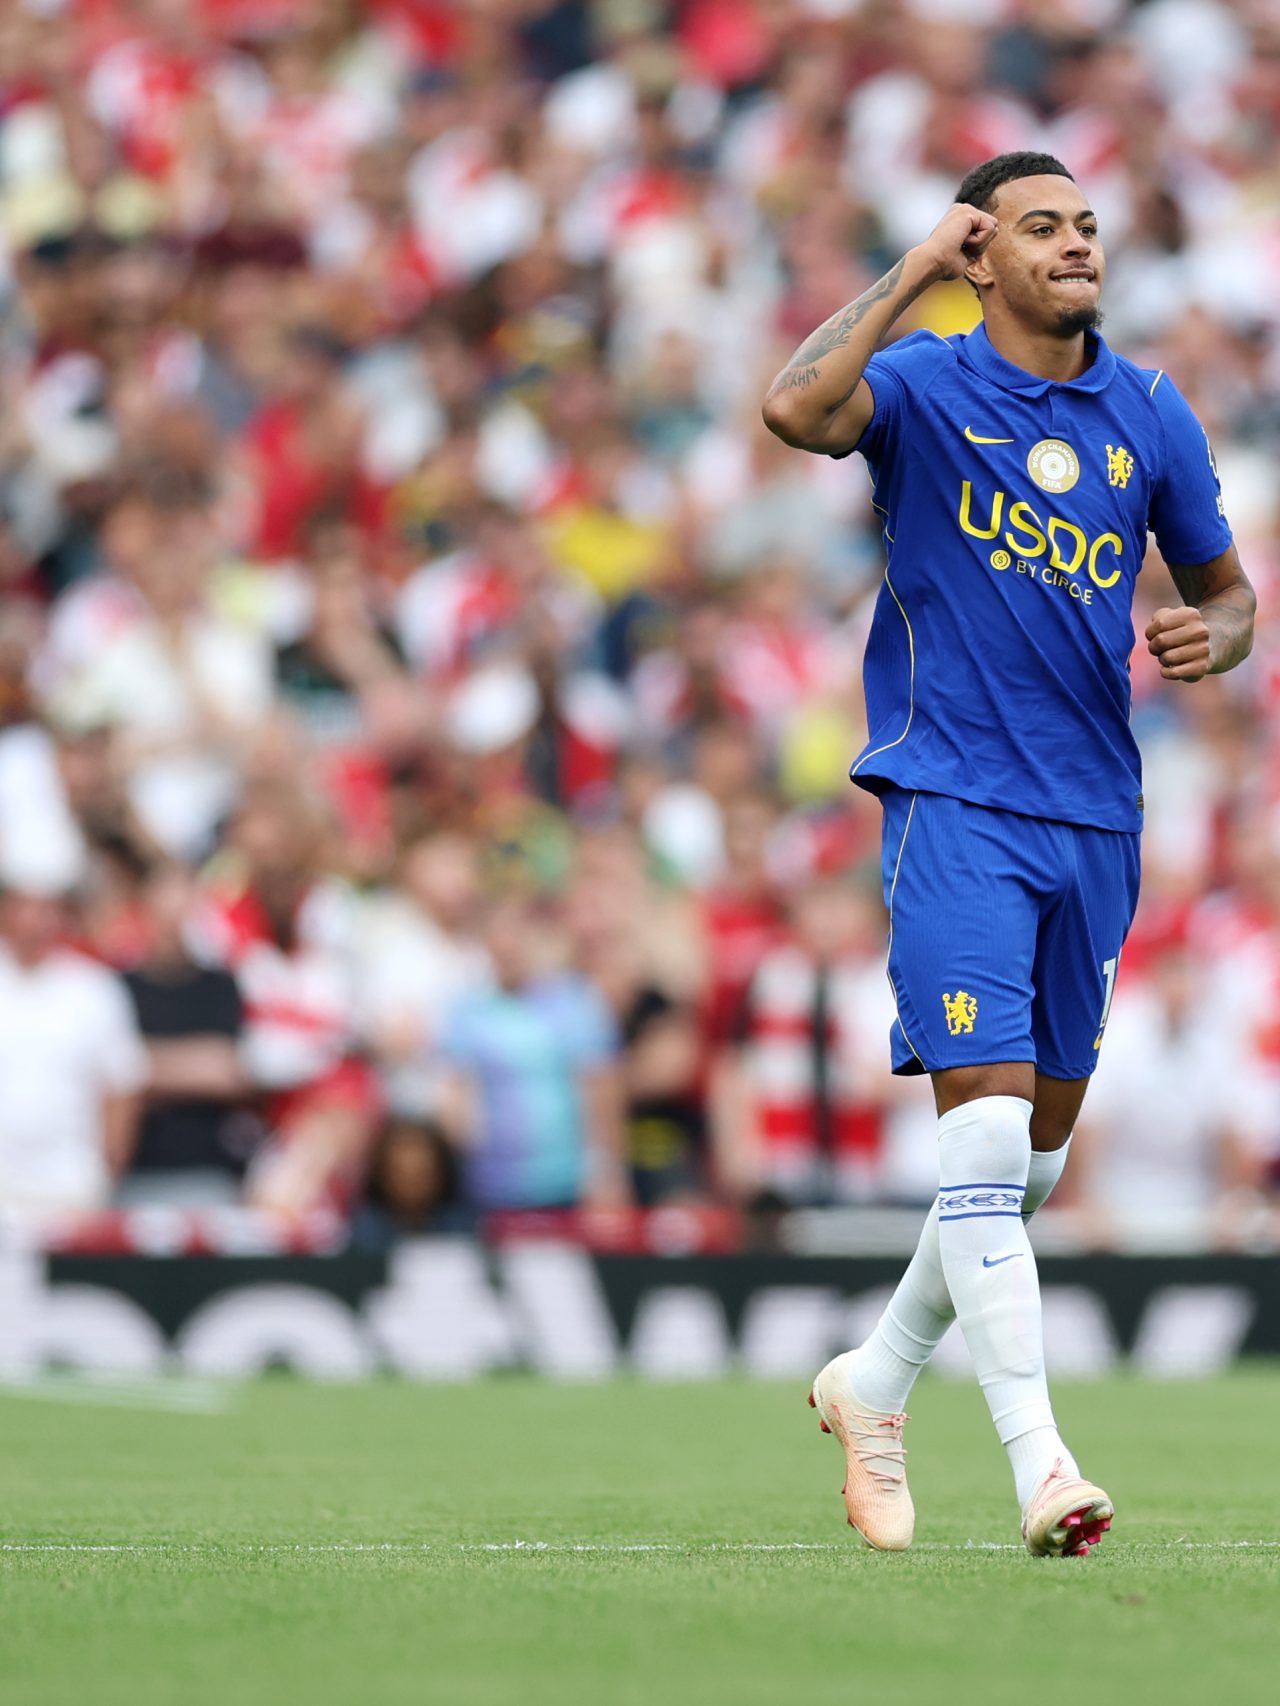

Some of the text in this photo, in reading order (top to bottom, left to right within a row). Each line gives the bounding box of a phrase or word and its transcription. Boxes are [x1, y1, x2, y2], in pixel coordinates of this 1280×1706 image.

[1032, 443, 1076, 477] WORLD CHAMPIONS
[1042, 478, 1063, 490] FIFA
[958, 480, 1123, 588] USDC
[1016, 560, 1094, 606] BY CIRCLE
